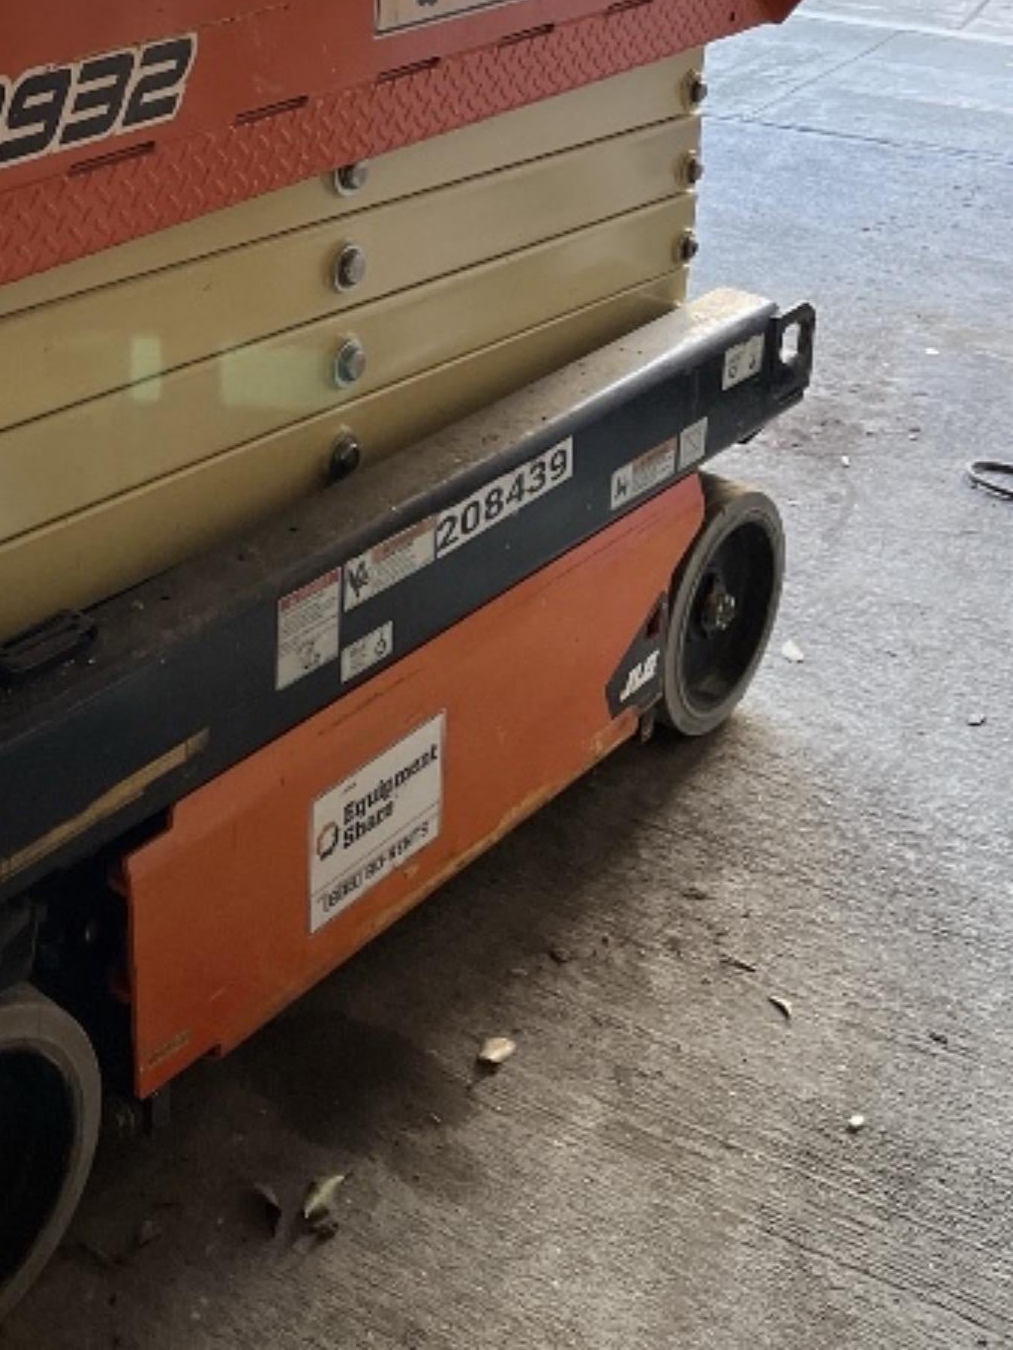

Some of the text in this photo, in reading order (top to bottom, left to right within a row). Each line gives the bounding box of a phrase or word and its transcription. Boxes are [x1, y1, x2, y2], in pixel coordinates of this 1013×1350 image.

[437, 448, 568, 551] 208439
[343, 744, 438, 826] Equipment
[343, 801, 394, 850] Share
